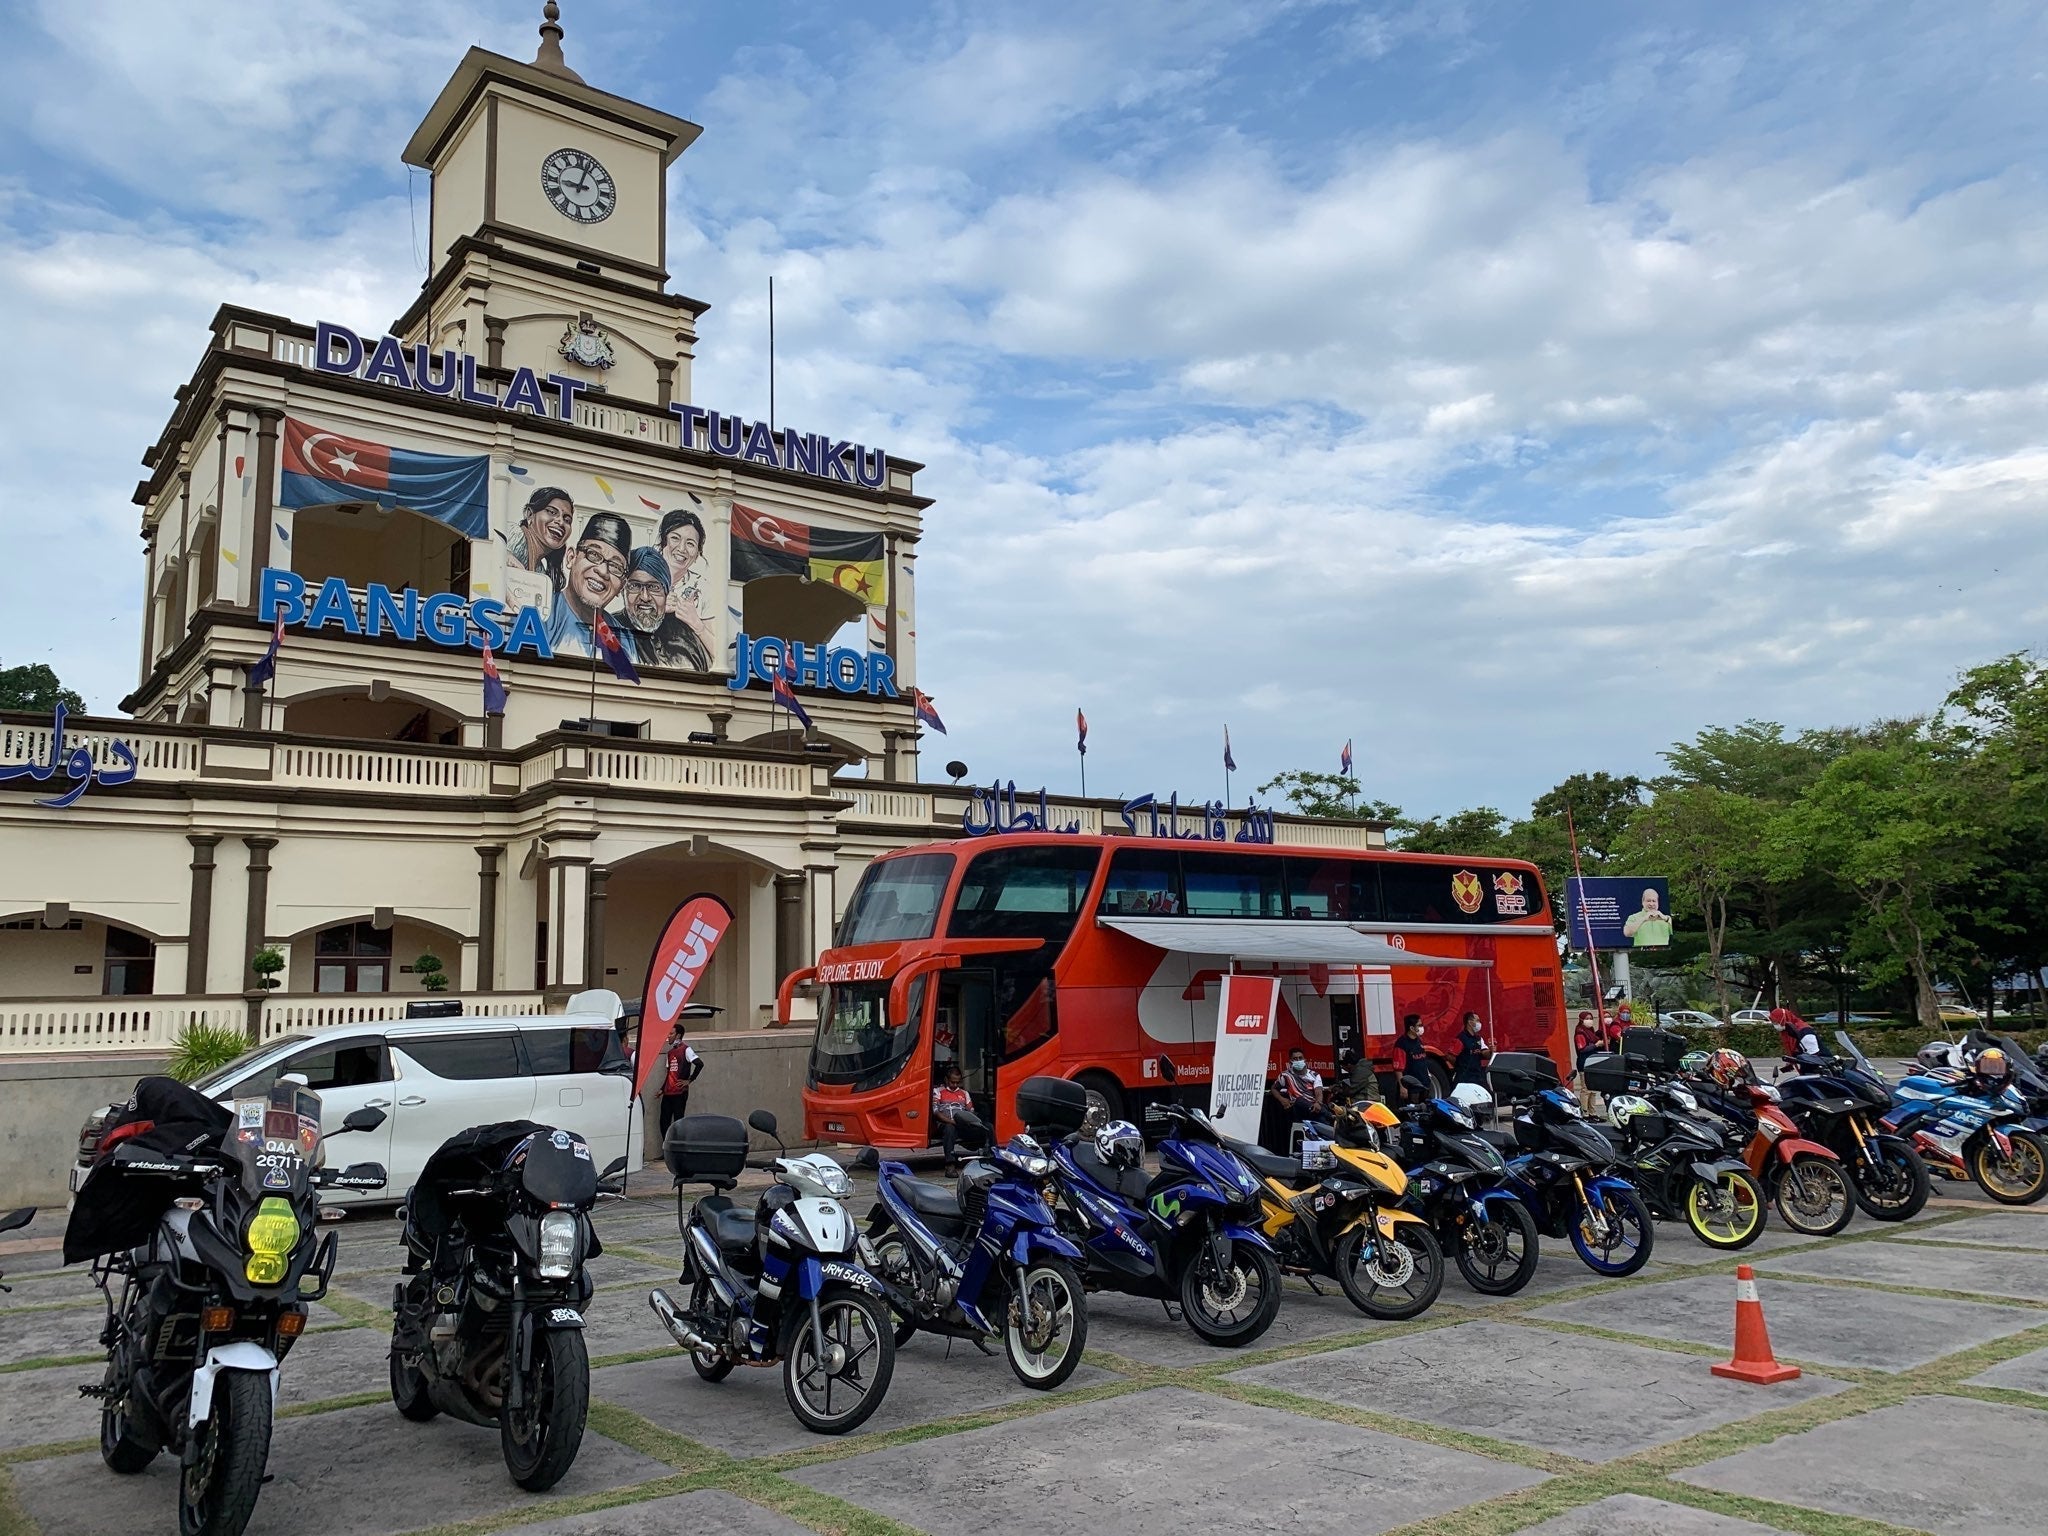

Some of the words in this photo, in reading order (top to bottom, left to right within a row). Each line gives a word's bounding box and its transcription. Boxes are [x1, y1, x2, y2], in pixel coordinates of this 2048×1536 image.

[315, 320, 587, 423] DAULAT
[669, 400, 887, 489] TUANKU
[258, 567, 554, 658] BANGSA
[727, 632, 898, 697] JOHOR
[1495, 895, 1526, 906] RED
[655, 917, 719, 1022] GIVI
[820, 963, 852, 982] EXPLORE.
[854, 961, 885, 980] ENJOY.
[1234, 1014, 1263, 1028] GIVI
[1177, 1063, 1209, 1077] Malaysia
[1217, 1073, 1263, 1092] WELCOME!
[1215, 1092, 1231, 1108] GIVI
[1232, 1091, 1260, 1108] PEOPLE
[266, 1140, 296, 1155] QAA
[127, 1161, 180, 1171] arkbusters
[256, 1154, 290, 1168] 2671
[293, 1158, 303, 1170] T
[1120, 1231, 1147, 1257] ENEOS
[821, 1262, 845, 1278] JRM
[842, 1269, 873, 1287] 5452
